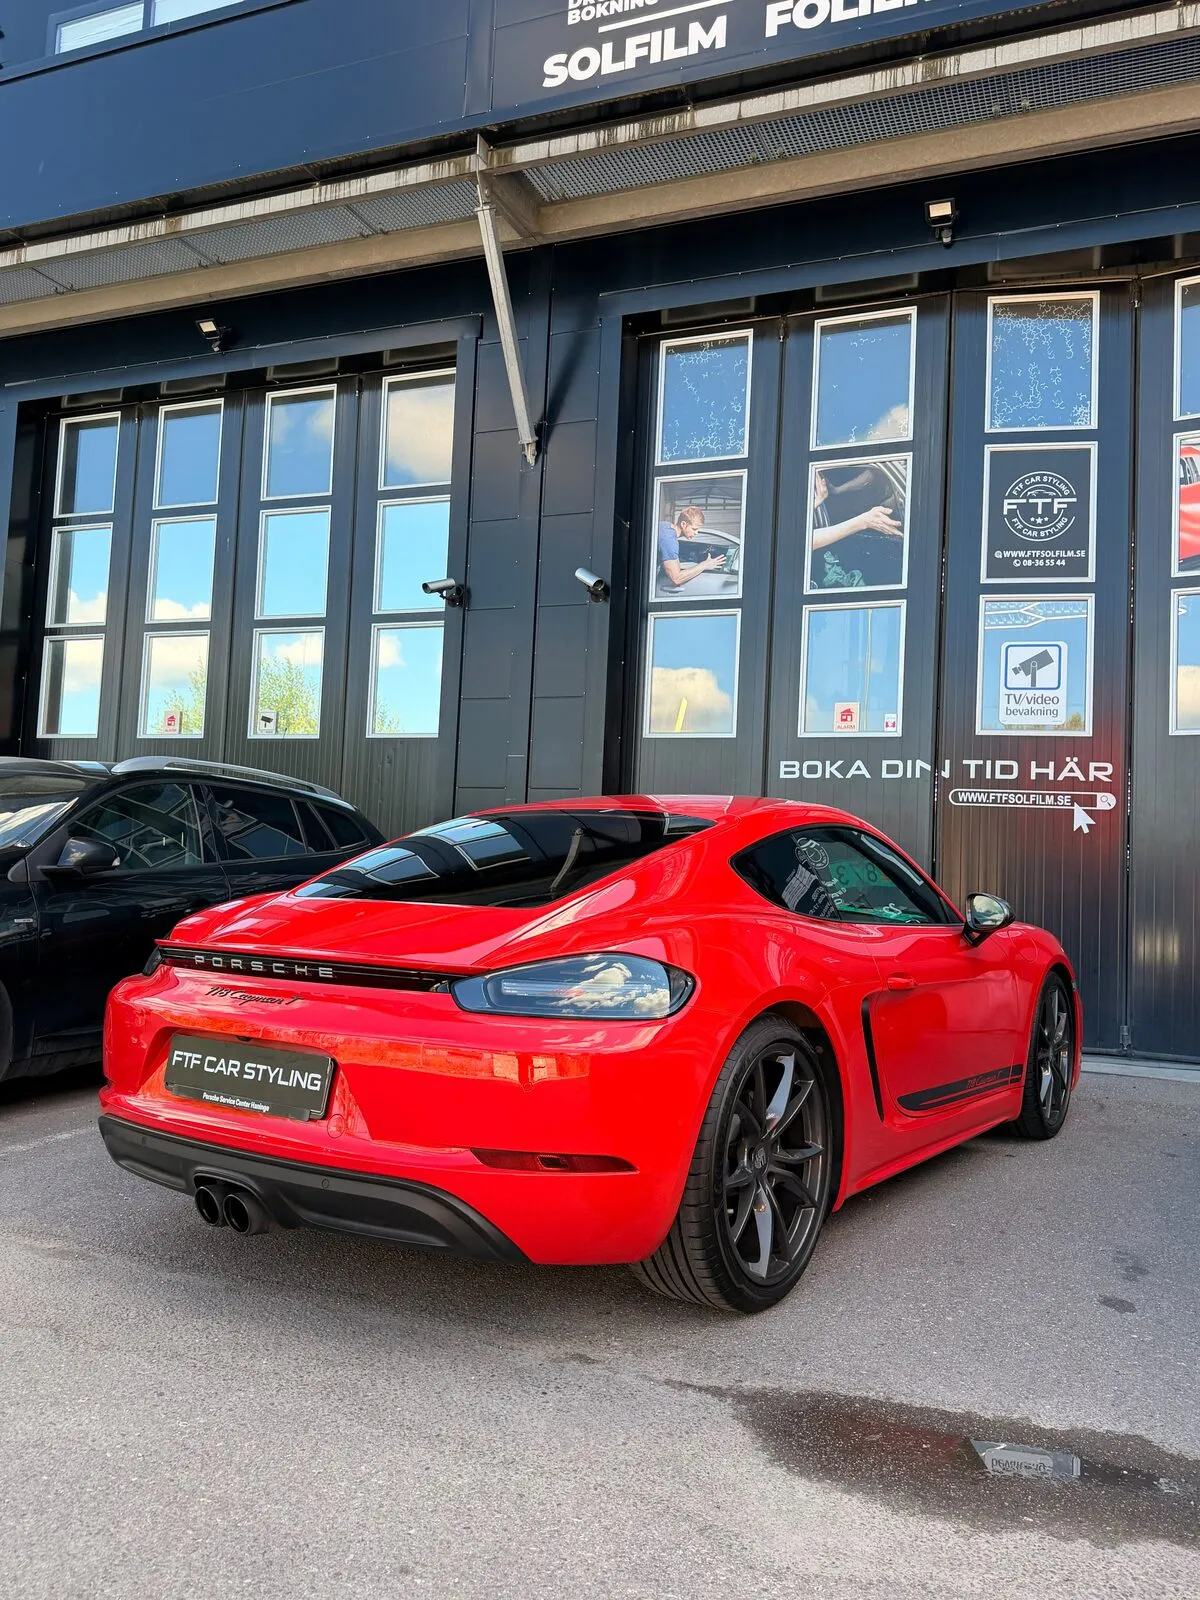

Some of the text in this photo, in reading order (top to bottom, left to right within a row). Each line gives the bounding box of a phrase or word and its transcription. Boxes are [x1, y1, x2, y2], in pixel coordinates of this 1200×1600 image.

[765, 0, 936, 38] FOL
[542, 14, 728, 88] SOLFILM
[1012, 475, 1070, 496] FTF CAR STYLING
[1003, 497, 1077, 515] FTF
[1011, 517, 1068, 537] FTF CAR STYLING
[1003, 550, 1086, 558] WWW.FTFSOLFILM.SE
[1022, 559, 1066, 567] 08-36 55 44
[1004, 692, 1060, 706] TV/video
[1005, 706, 1059, 718] bevakning
[779, 756, 1113, 783] BOKA DIN TID HÄR
[957, 791, 1072, 807] WWW.FTFSOLFILM.SE
[194, 955, 333, 978] PORSCHE
[172, 1050, 322, 1092] FTF CAR STYLING
